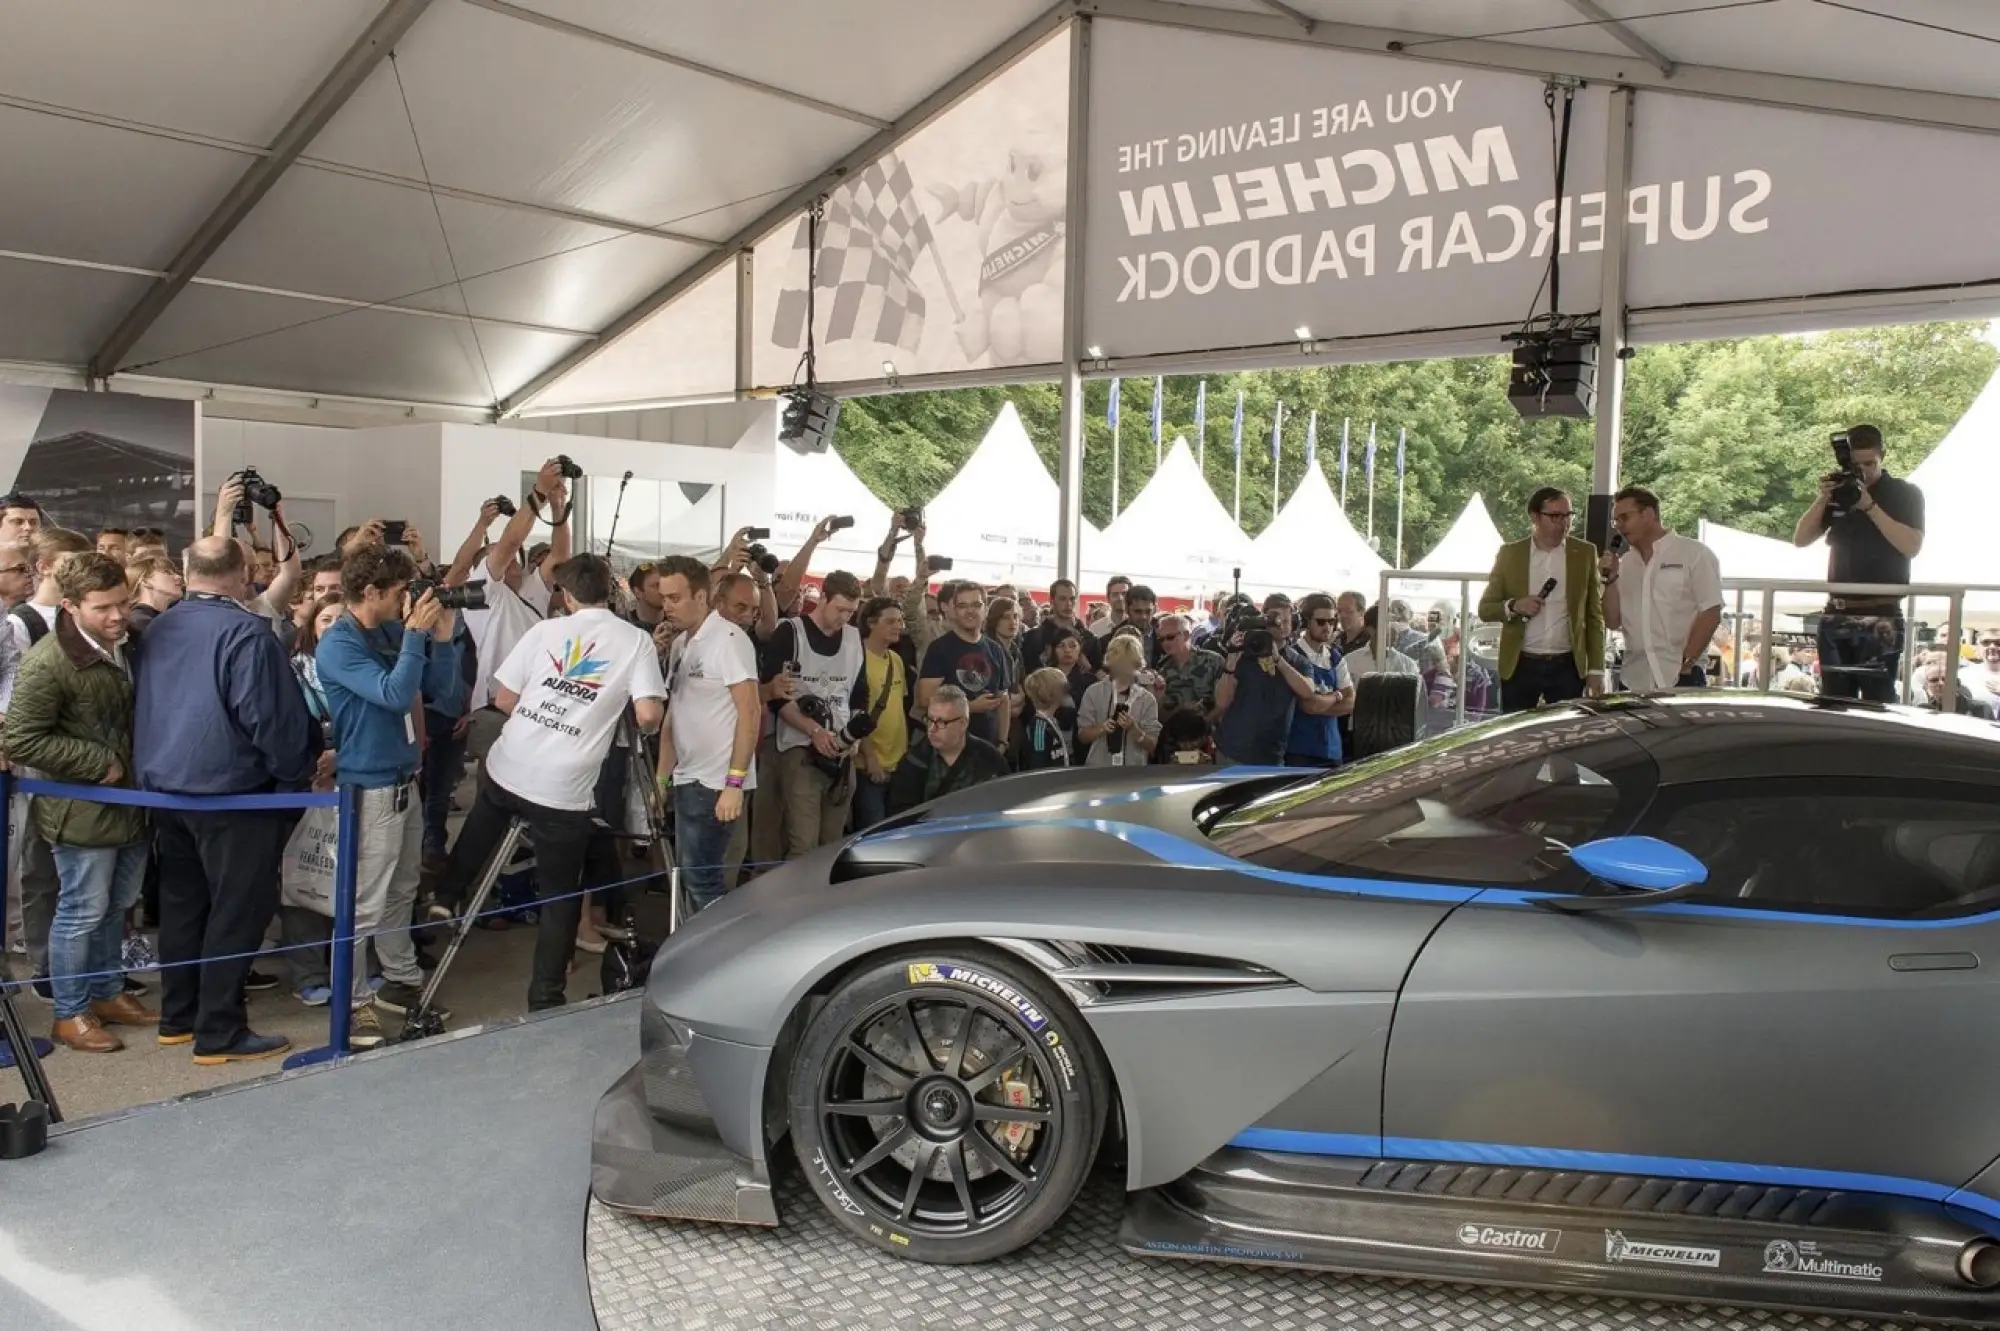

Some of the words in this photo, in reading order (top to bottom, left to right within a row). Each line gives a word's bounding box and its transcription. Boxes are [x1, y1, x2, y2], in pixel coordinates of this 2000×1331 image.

[541, 677, 598, 702] AURORA
[540, 699, 568, 717] HOST
[951, 968, 1043, 1023] MICHELIN
[1479, 1227, 1548, 1249] Castrol
[1628, 1245, 1717, 1263] MICHELIN
[1797, 1257, 1884, 1277] Multimatic
